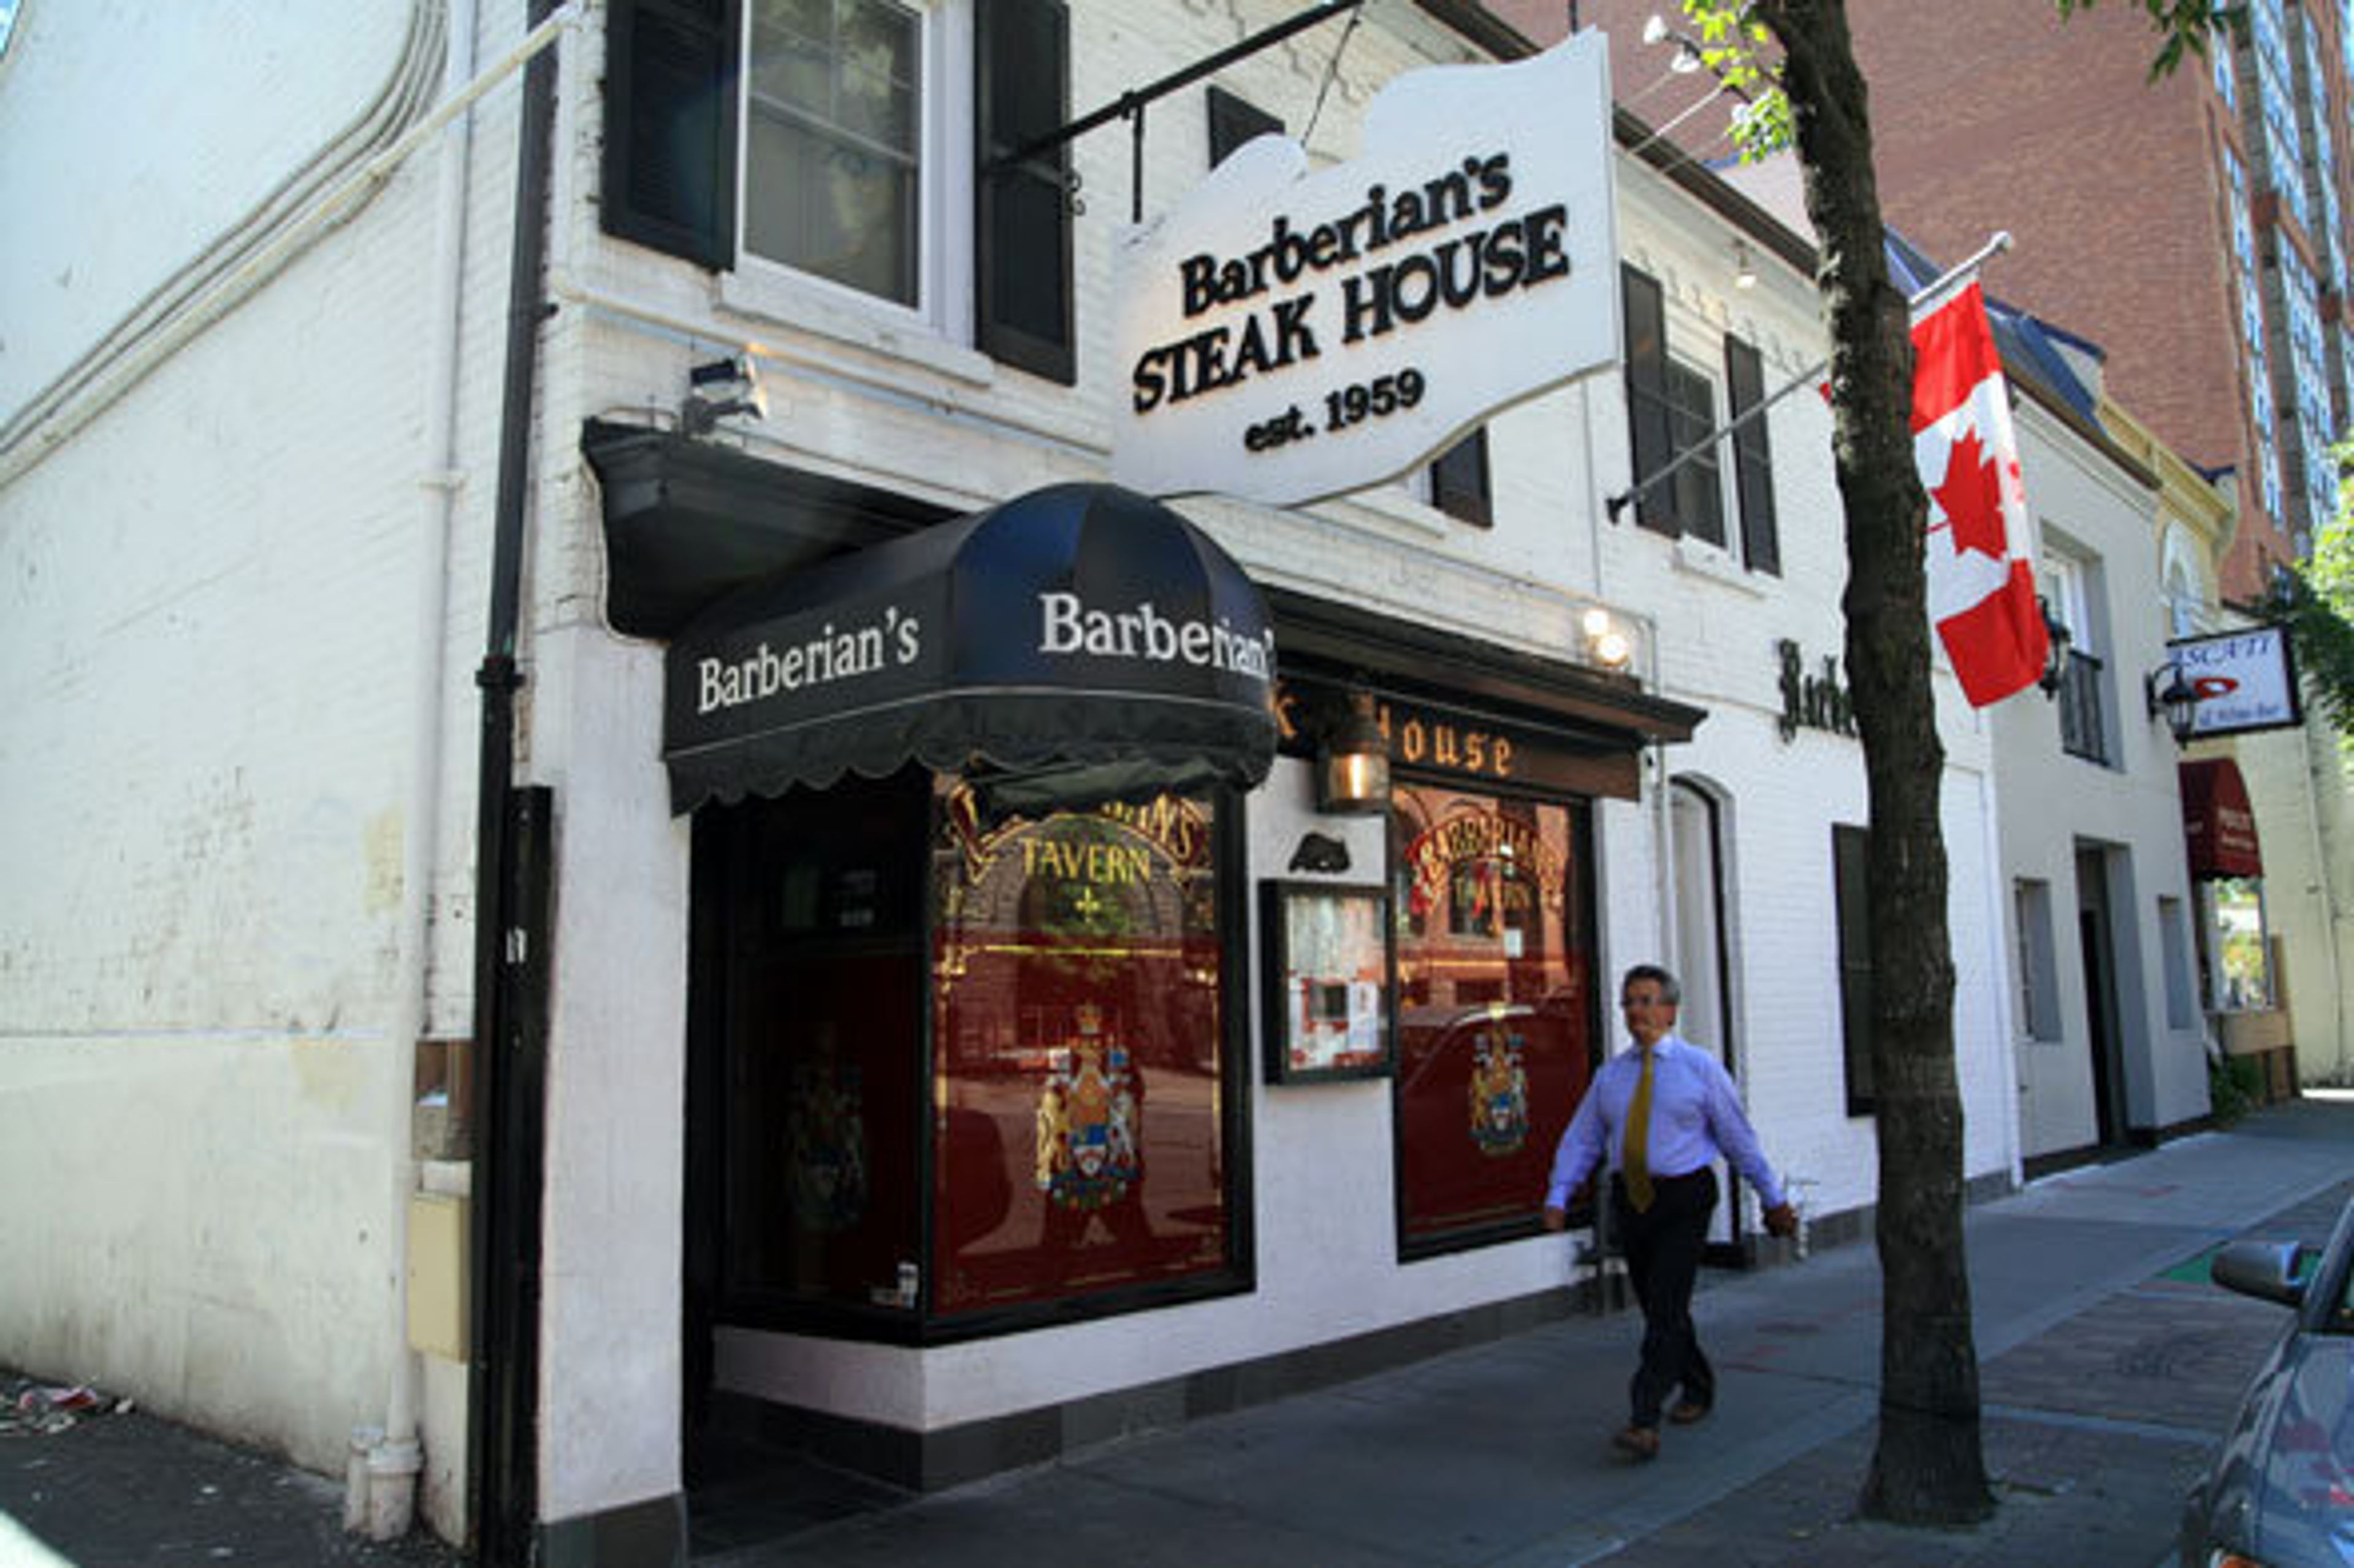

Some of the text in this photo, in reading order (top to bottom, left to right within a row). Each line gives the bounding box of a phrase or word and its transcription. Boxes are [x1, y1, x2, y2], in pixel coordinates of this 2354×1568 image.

[1179, 153, 1511, 319] Barberian's
[1132, 205, 1571, 414] STEAK HOUSE
[1244, 368, 1426, 452] est. 1959
[697, 607, 921, 715] Barberian's
[1037, 591, 1275, 682] Barberian'
[1019, 836, 1152, 884] TAVERN
